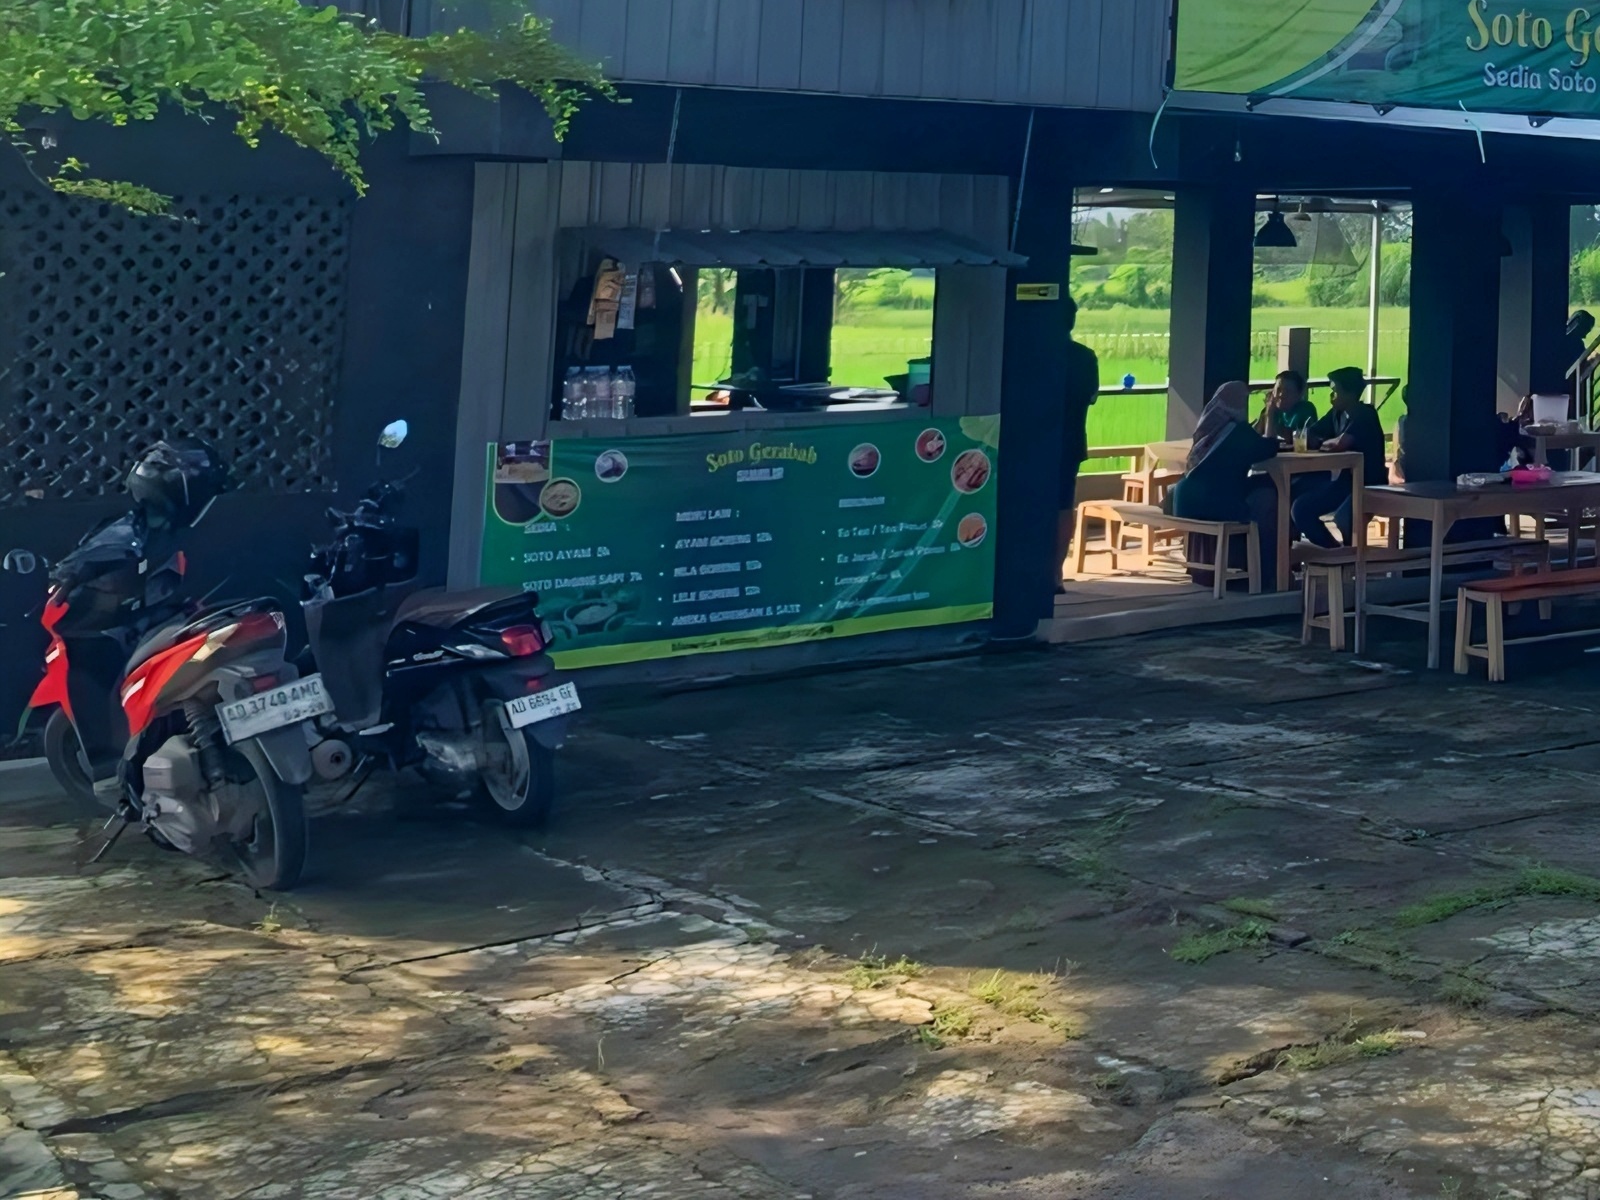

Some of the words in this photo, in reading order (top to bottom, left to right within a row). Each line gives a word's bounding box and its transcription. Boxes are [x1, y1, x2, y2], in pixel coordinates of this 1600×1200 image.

[1483, 62, 1541, 90] Sedia
[1549, 67, 1597, 93] Soto
[524, 551, 554, 563] SOTO
[556, 547, 591, 560] AYAM
